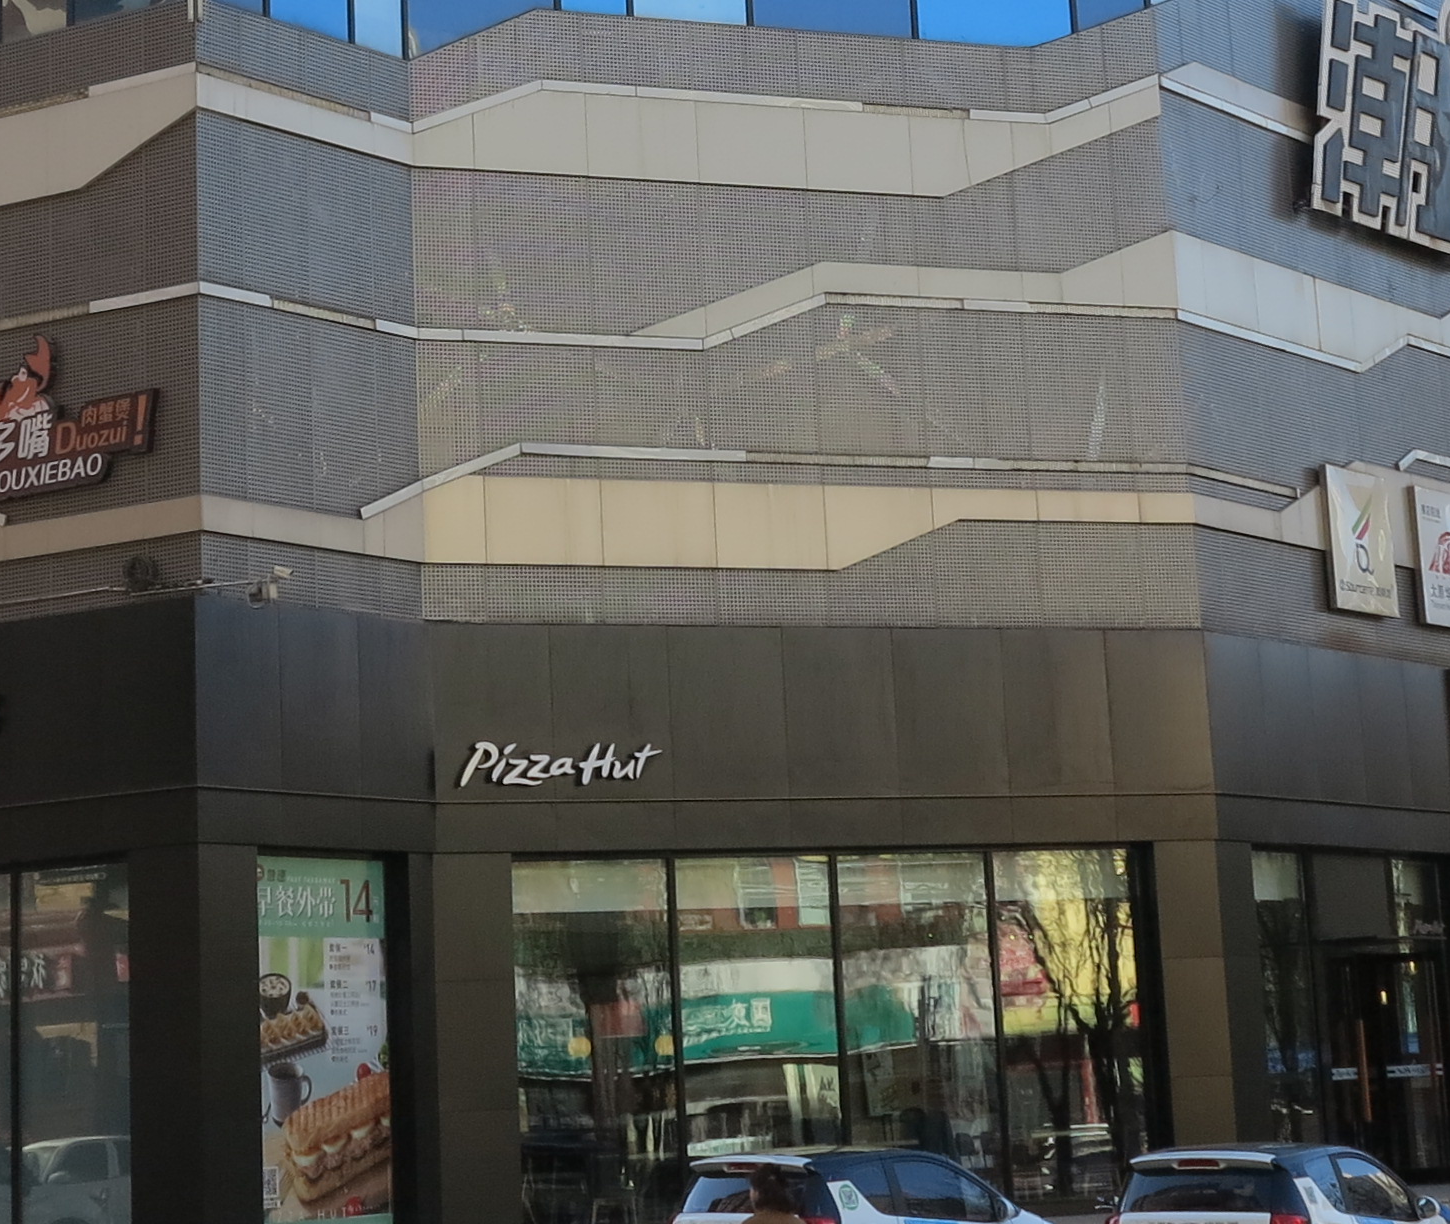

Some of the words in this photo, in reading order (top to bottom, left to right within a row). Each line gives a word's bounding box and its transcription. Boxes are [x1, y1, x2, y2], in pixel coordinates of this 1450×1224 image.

[79, 396, 131, 428] 肉蟹煲
[339, 878, 373, 923] 14
